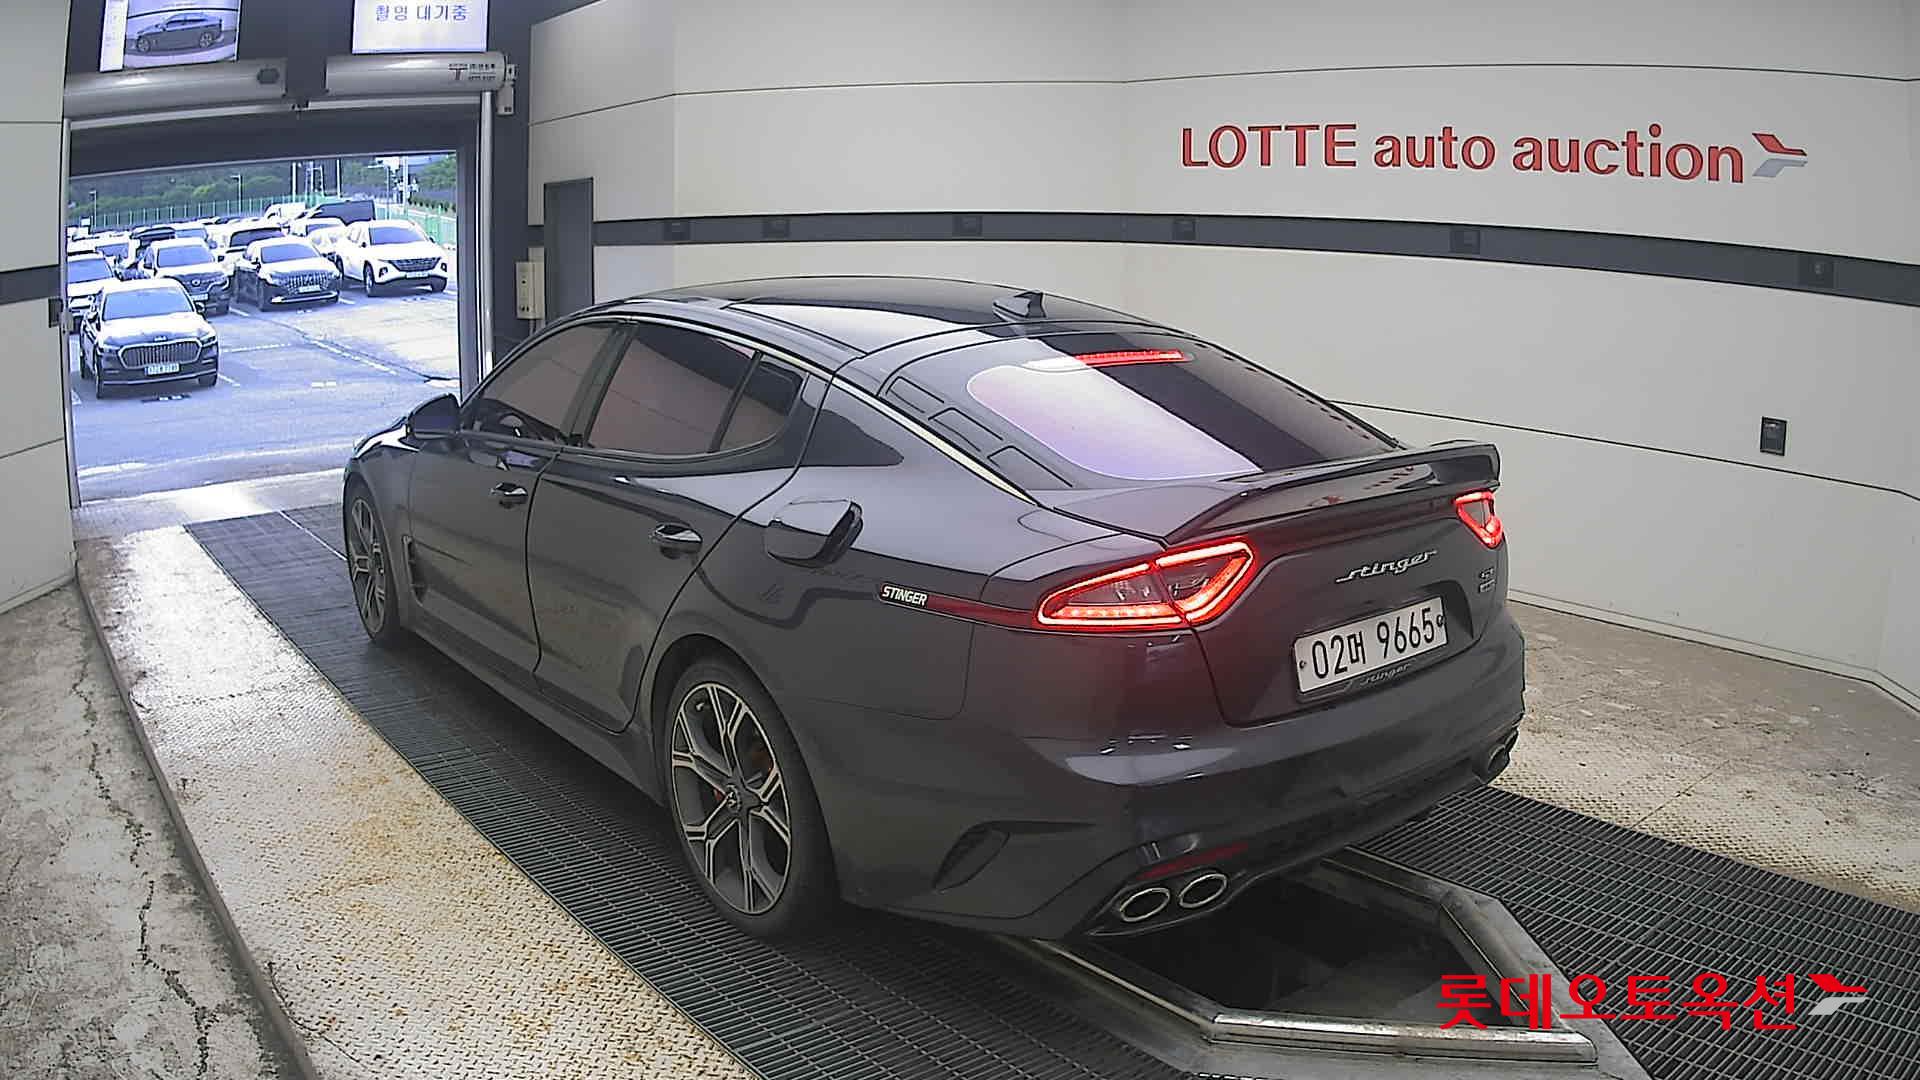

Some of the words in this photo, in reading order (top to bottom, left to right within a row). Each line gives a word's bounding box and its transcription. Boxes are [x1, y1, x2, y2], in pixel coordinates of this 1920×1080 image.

[416, 4, 467, 21] 대기중
[1181, 124, 1357, 167] LOTTE
[1373, 126, 1497, 170] auto
[1513, 124, 1744, 183] auction
[882, 586, 927, 606] STINGER
[1312, 631, 1366, 678] 02머
[1376, 607, 1435, 659] 9665
